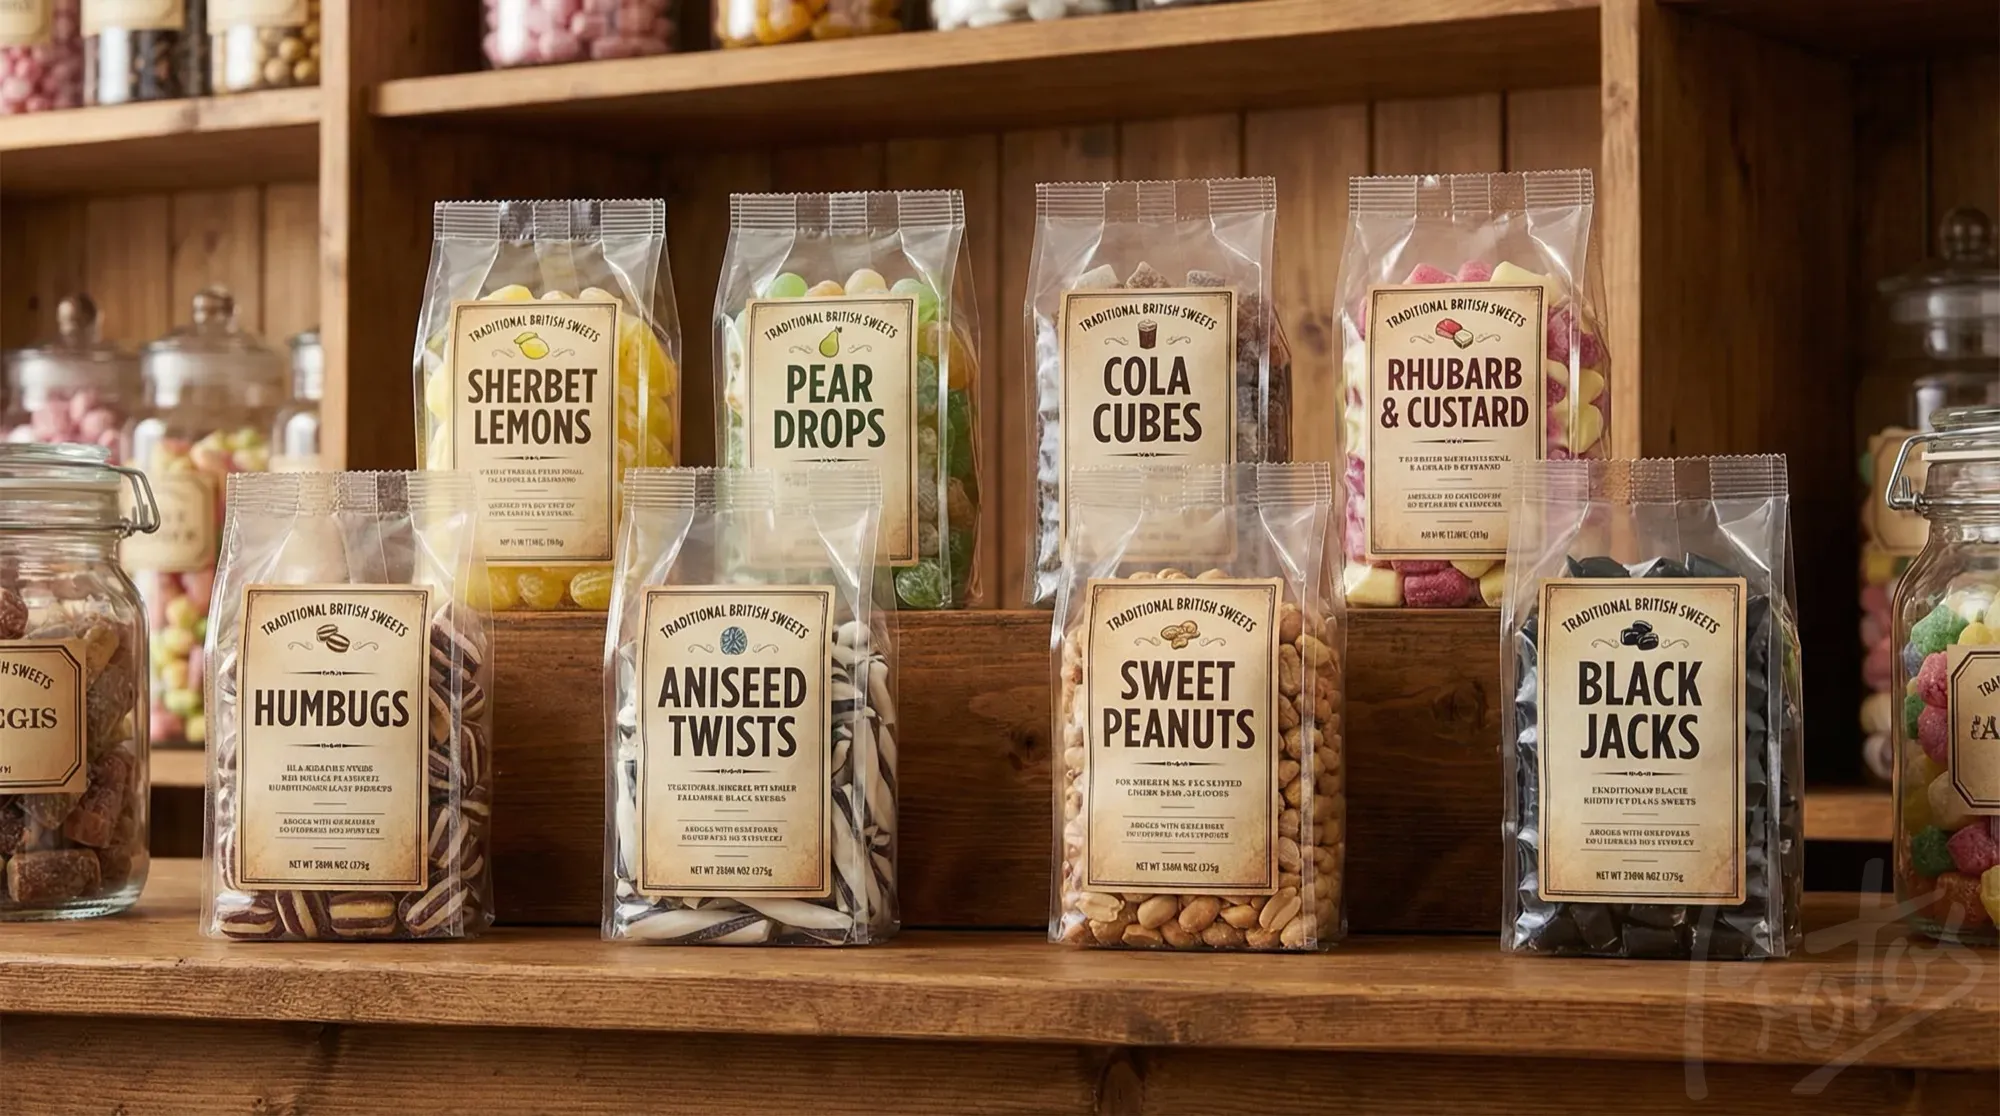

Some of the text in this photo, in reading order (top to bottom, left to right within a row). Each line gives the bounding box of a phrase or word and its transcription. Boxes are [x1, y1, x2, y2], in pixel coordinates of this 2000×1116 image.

[468, 314, 600, 343] TRADITIONAL BRITISH SWEETS
[764, 311, 898, 341] TRADITIONAL BRITISH SWEETS
[1078, 303, 1217, 332] TRADITIONAL BRITISH SWEETS
[1385, 298, 1527, 329] TRADITIONAL BRITISH SWEETS
[467, 368, 598, 404] SHERBET
[786, 363, 873, 404] PEAR
[1103, 356, 1191, 397] COLA
[1387, 357, 1523, 391] RHUBARB
[474, 408, 592, 445] LEMONS
[774, 408, 886, 449] DROPS
[1092, 402, 1203, 443] CUBES
[1380, 395, 1529, 429] & CUSTARD
[260, 602, 409, 638] TRADITIONAL BRITISH SWEETS
[660, 604, 810, 639] TRADITIONAL BRITISH SWEETS
[1106, 597, 1257, 633] TRADITIONAL BRITISH SWEETS
[1561, 597, 1721, 634] TRADITIONAL BRITISH SWEETS
[11, 663, 54, 690] SWEETS
[657, 666, 807, 708] ANISEED
[1120, 660, 1236, 701] SWEET
[1578, 660, 1703, 706] BLACK
[254, 689, 410, 728] HUMBUGS
[668, 715, 797, 758] TWISTS
[1103, 707, 1256, 750] PEANUTS
[1580, 713, 1700, 760] JACKS
[690, 865, 703, 875] NET
[704, 866, 714, 875] WT
[1136, 862, 1149, 871] NET
[1149, 862, 1160, 872] WT
[1596, 871, 1610, 881] NET
[1610, 871, 1622, 881] WT
